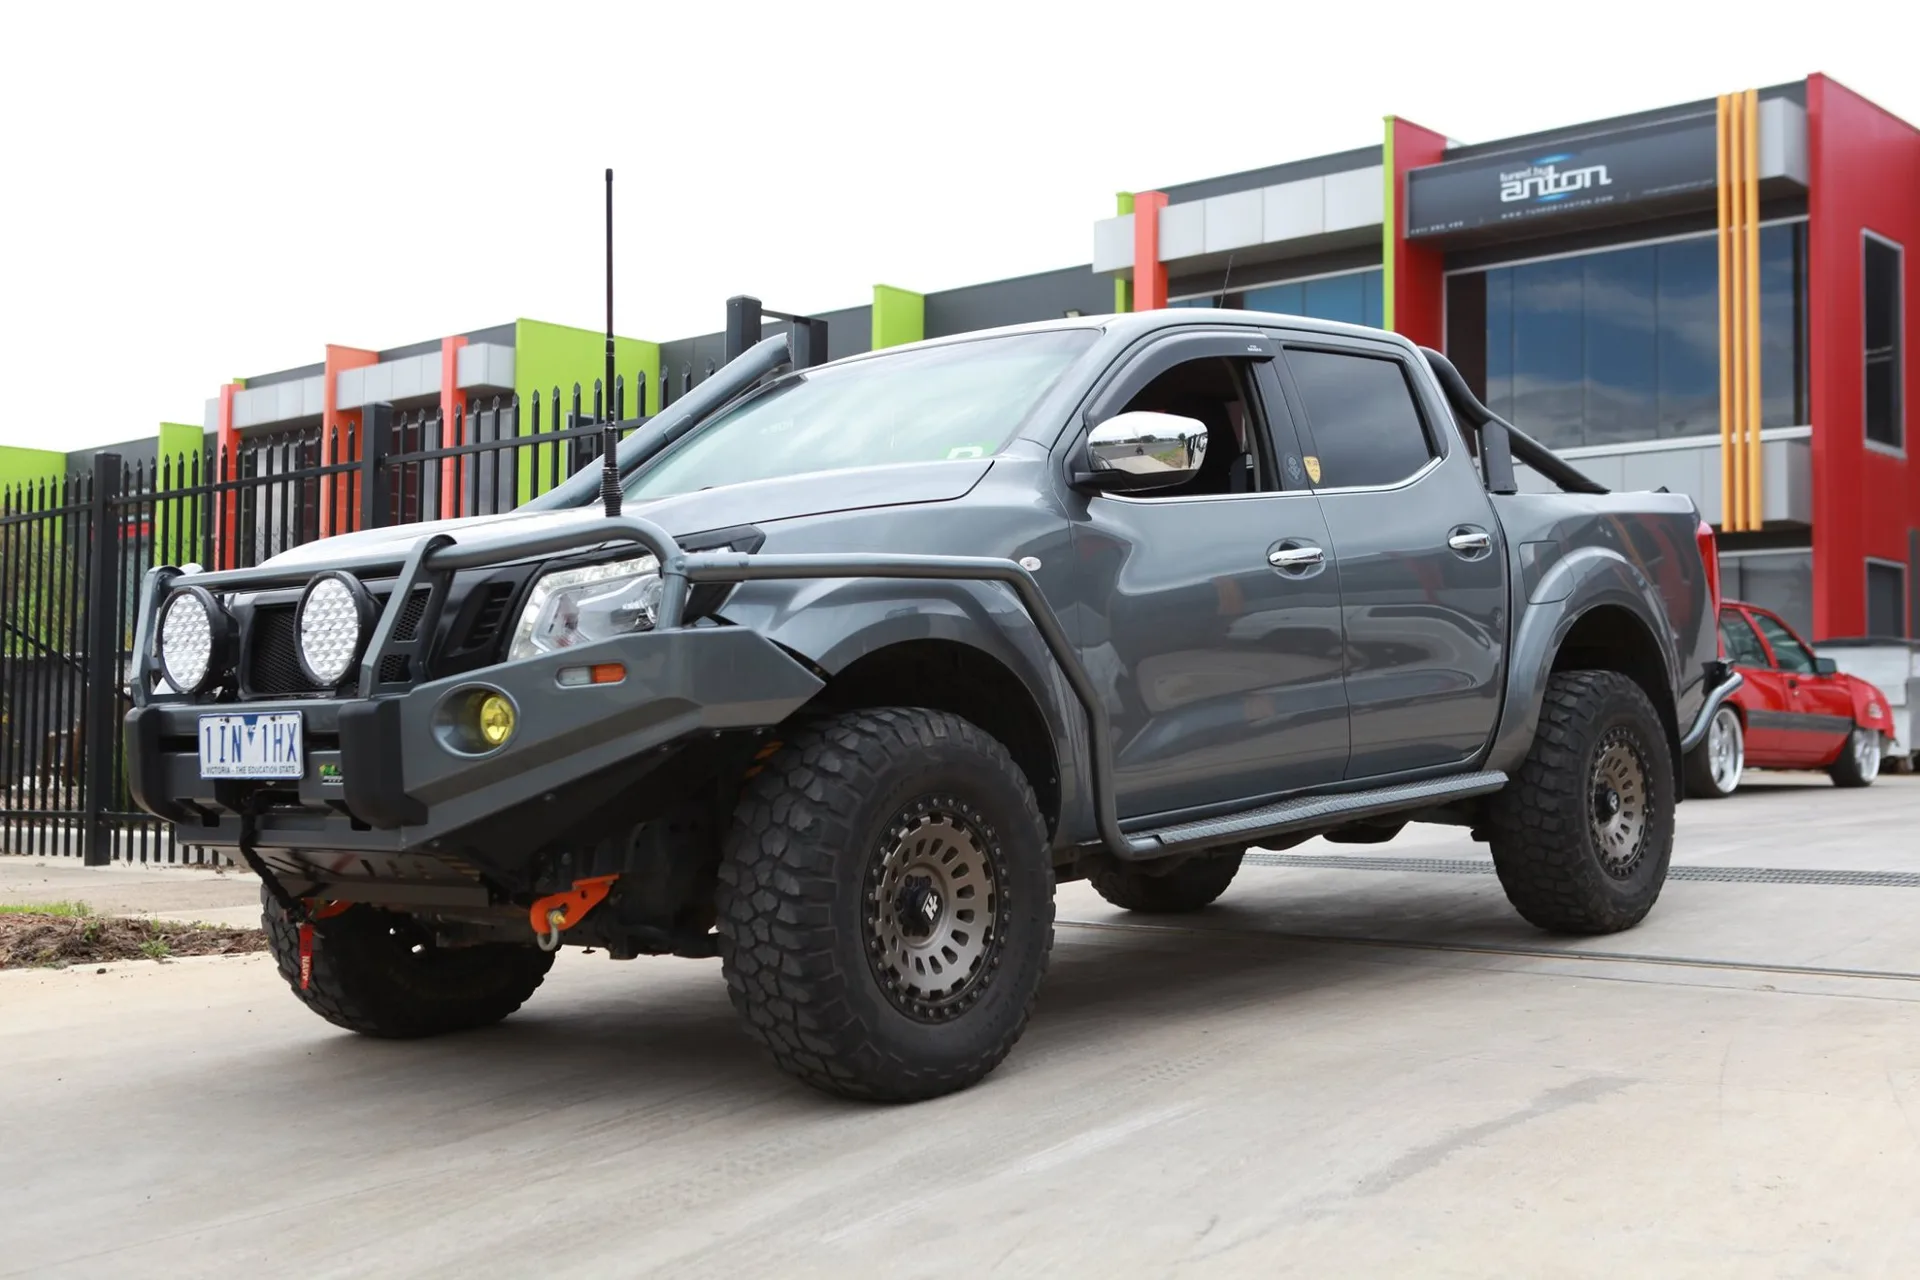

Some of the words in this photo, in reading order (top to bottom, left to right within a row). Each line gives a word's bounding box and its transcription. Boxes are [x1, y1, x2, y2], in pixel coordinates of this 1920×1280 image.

[1501, 164, 1613, 202] anton
[262, 723, 297, 763] 1HX
[206, 766, 231, 775] VICTORIA
[236, 766, 246, 775] THE
[248, 765, 278, 774] EDUCATION
[279, 765, 296, 774] STATE
